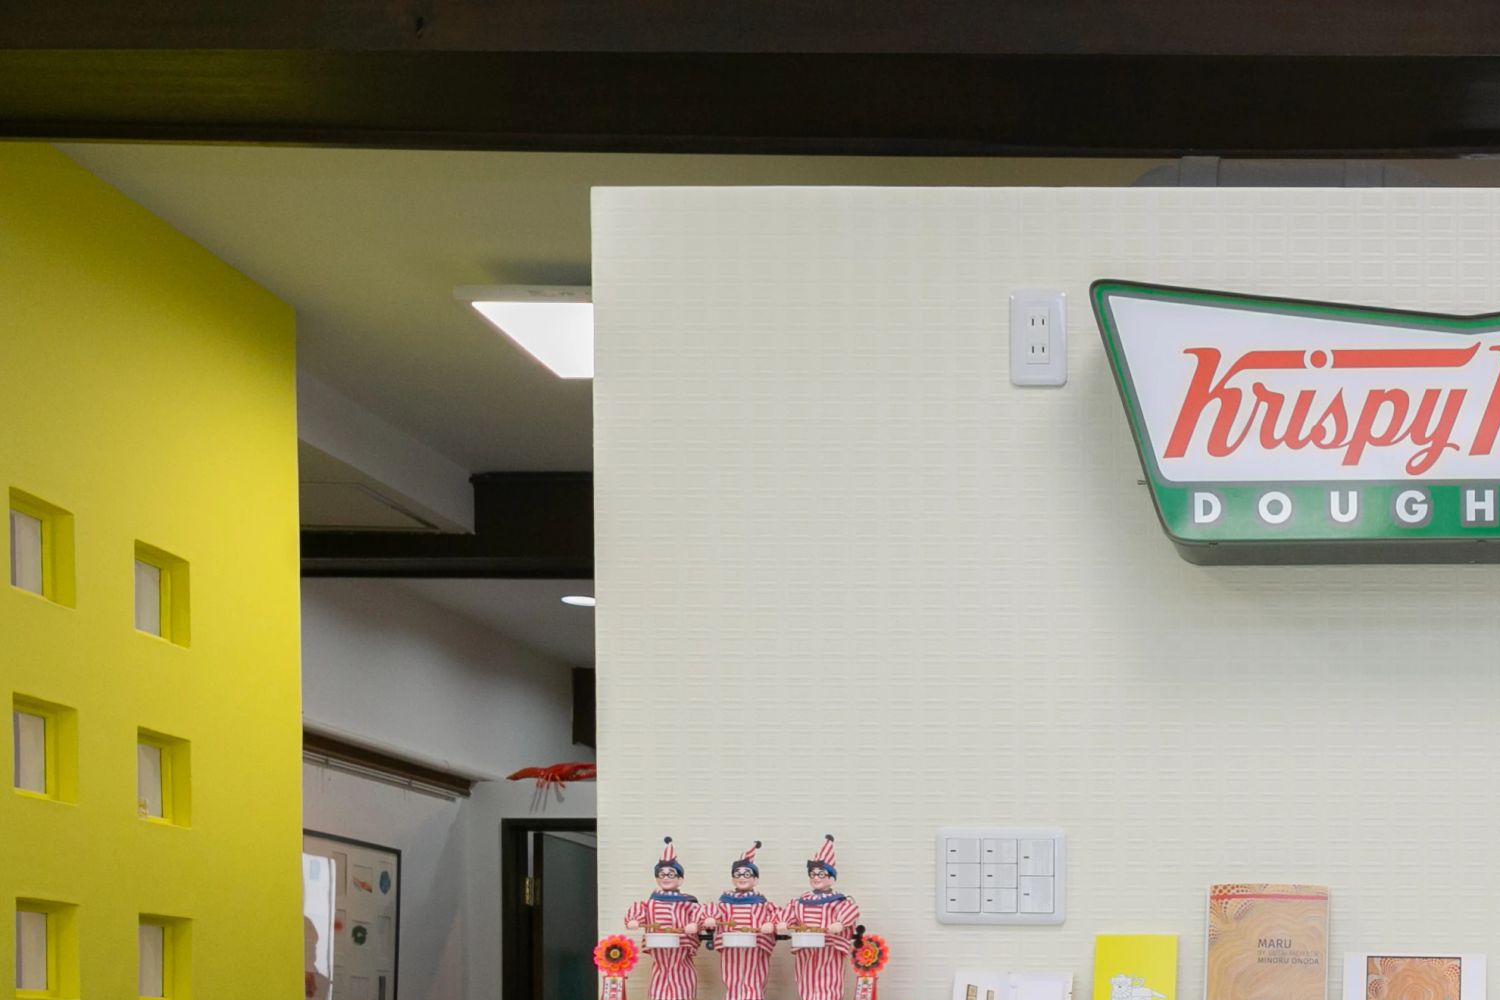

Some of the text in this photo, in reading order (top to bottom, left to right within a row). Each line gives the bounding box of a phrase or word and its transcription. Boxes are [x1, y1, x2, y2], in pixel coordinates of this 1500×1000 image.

[1163, 342, 1481, 475] Krispy
[1257, 938, 1292, 949] MARU
[1257, 956, 1320, 966] MINORU ONODA
